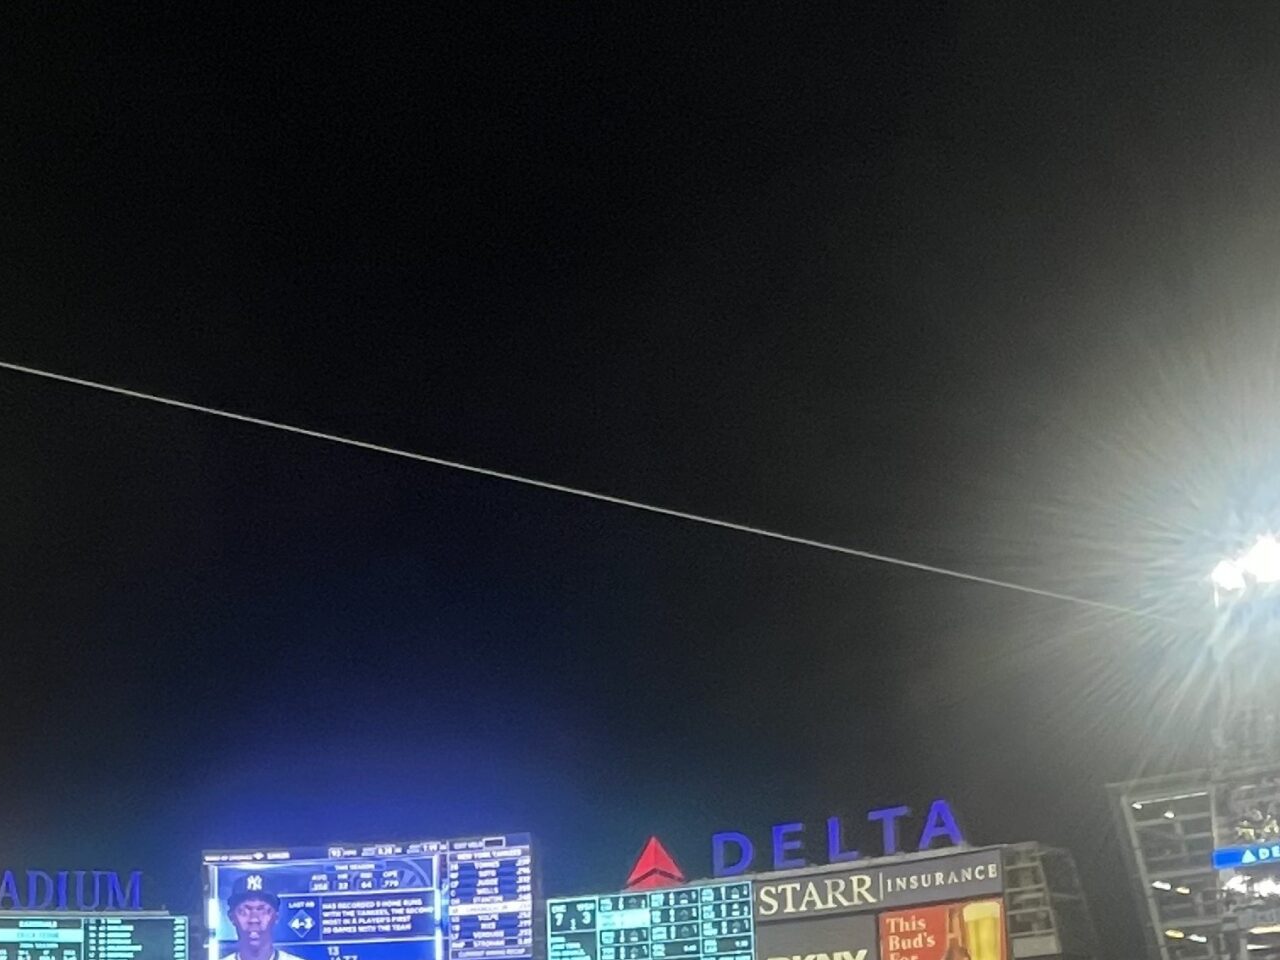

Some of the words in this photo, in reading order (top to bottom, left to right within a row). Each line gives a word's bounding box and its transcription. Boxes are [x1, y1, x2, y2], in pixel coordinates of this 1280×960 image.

[712, 797, 965, 877] DELTA
[758, 873, 877, 916] STARR
[886, 863, 998, 894] INSURANCE
[582, 911, 591, 925] 3
[885, 916, 927, 933] This
[888, 932, 936, 950] Bud's
[327, 945, 340, 956] 13
